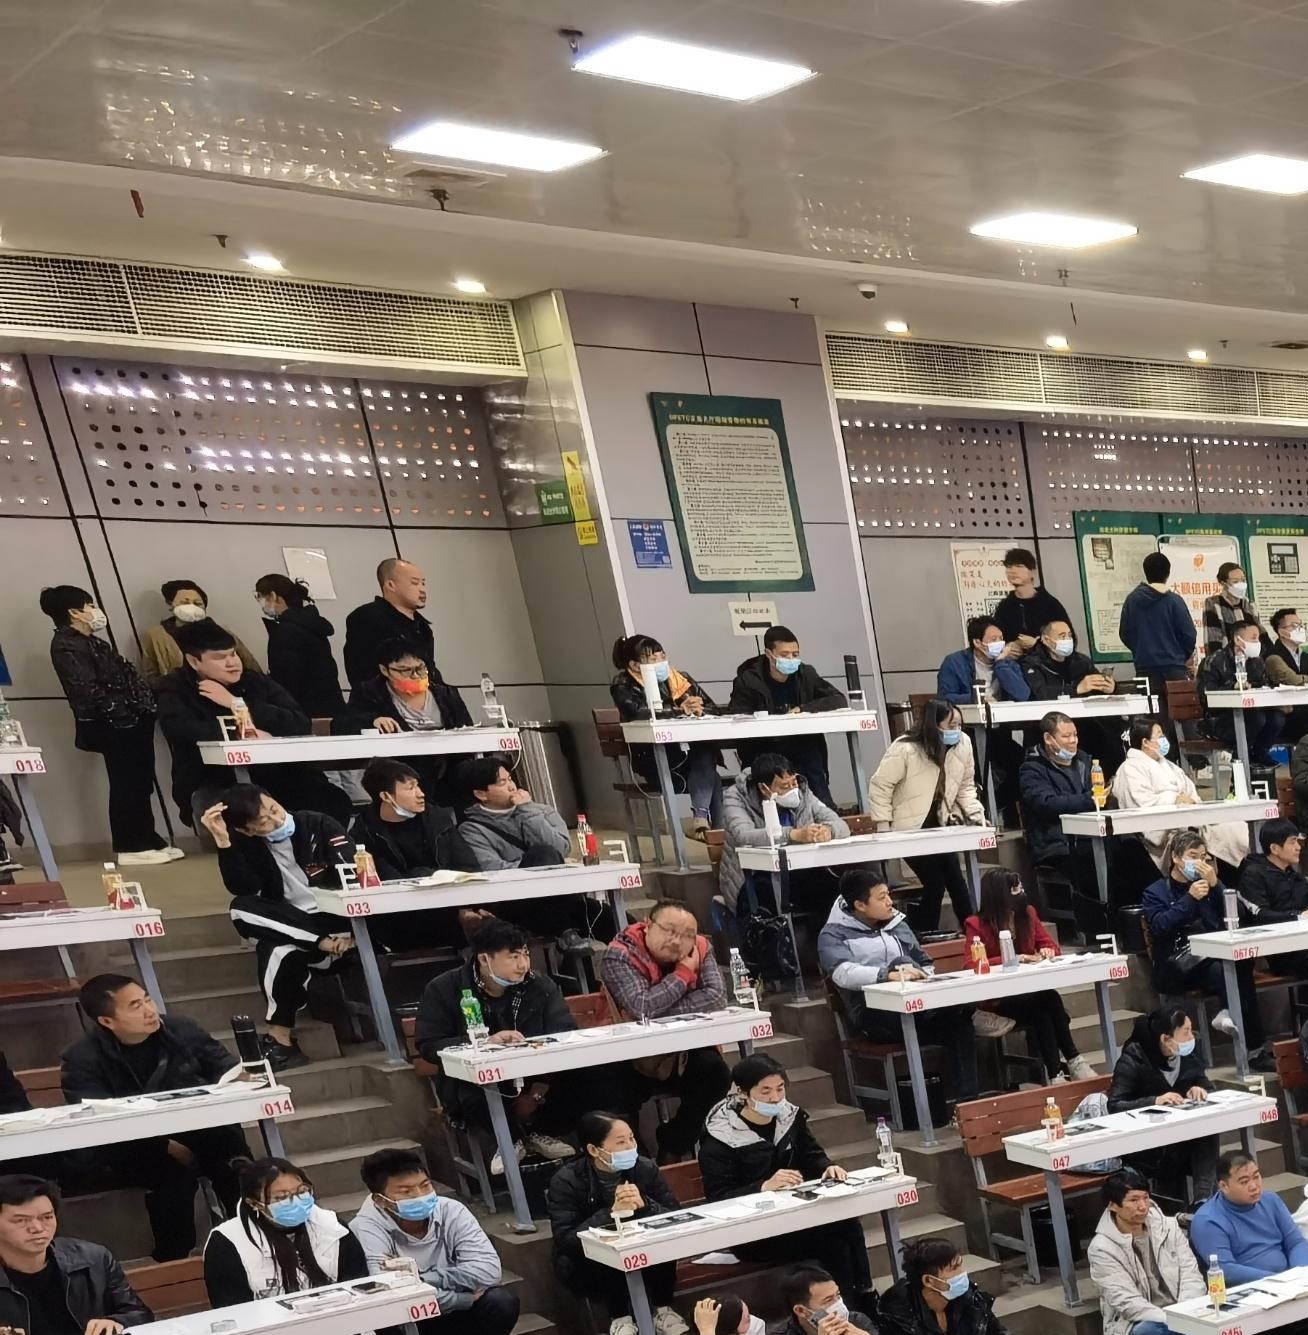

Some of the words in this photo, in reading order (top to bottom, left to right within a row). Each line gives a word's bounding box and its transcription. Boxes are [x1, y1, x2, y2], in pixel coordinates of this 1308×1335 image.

[861, 719, 877, 730] 054
[655, 731, 673, 742] 053
[227, 750, 251, 764] 035
[16, 759, 44, 772] 018
[979, 836, 996, 849] 052
[620, 875, 641, 888] 034
[346, 902, 371, 915] 033
[135, 921, 163, 936] 016
[905, 999, 924, 1012] 049
[752, 1024, 772, 1038] 032
[479, 1067, 501, 1082] 031
[264, 1101, 293, 1117] 014
[1052, 1155, 1070, 1170] 047
[897, 1190, 918, 1205] 030
[624, 1254, 648, 1270] 029
[410, 1302, 438, 1318] 012
